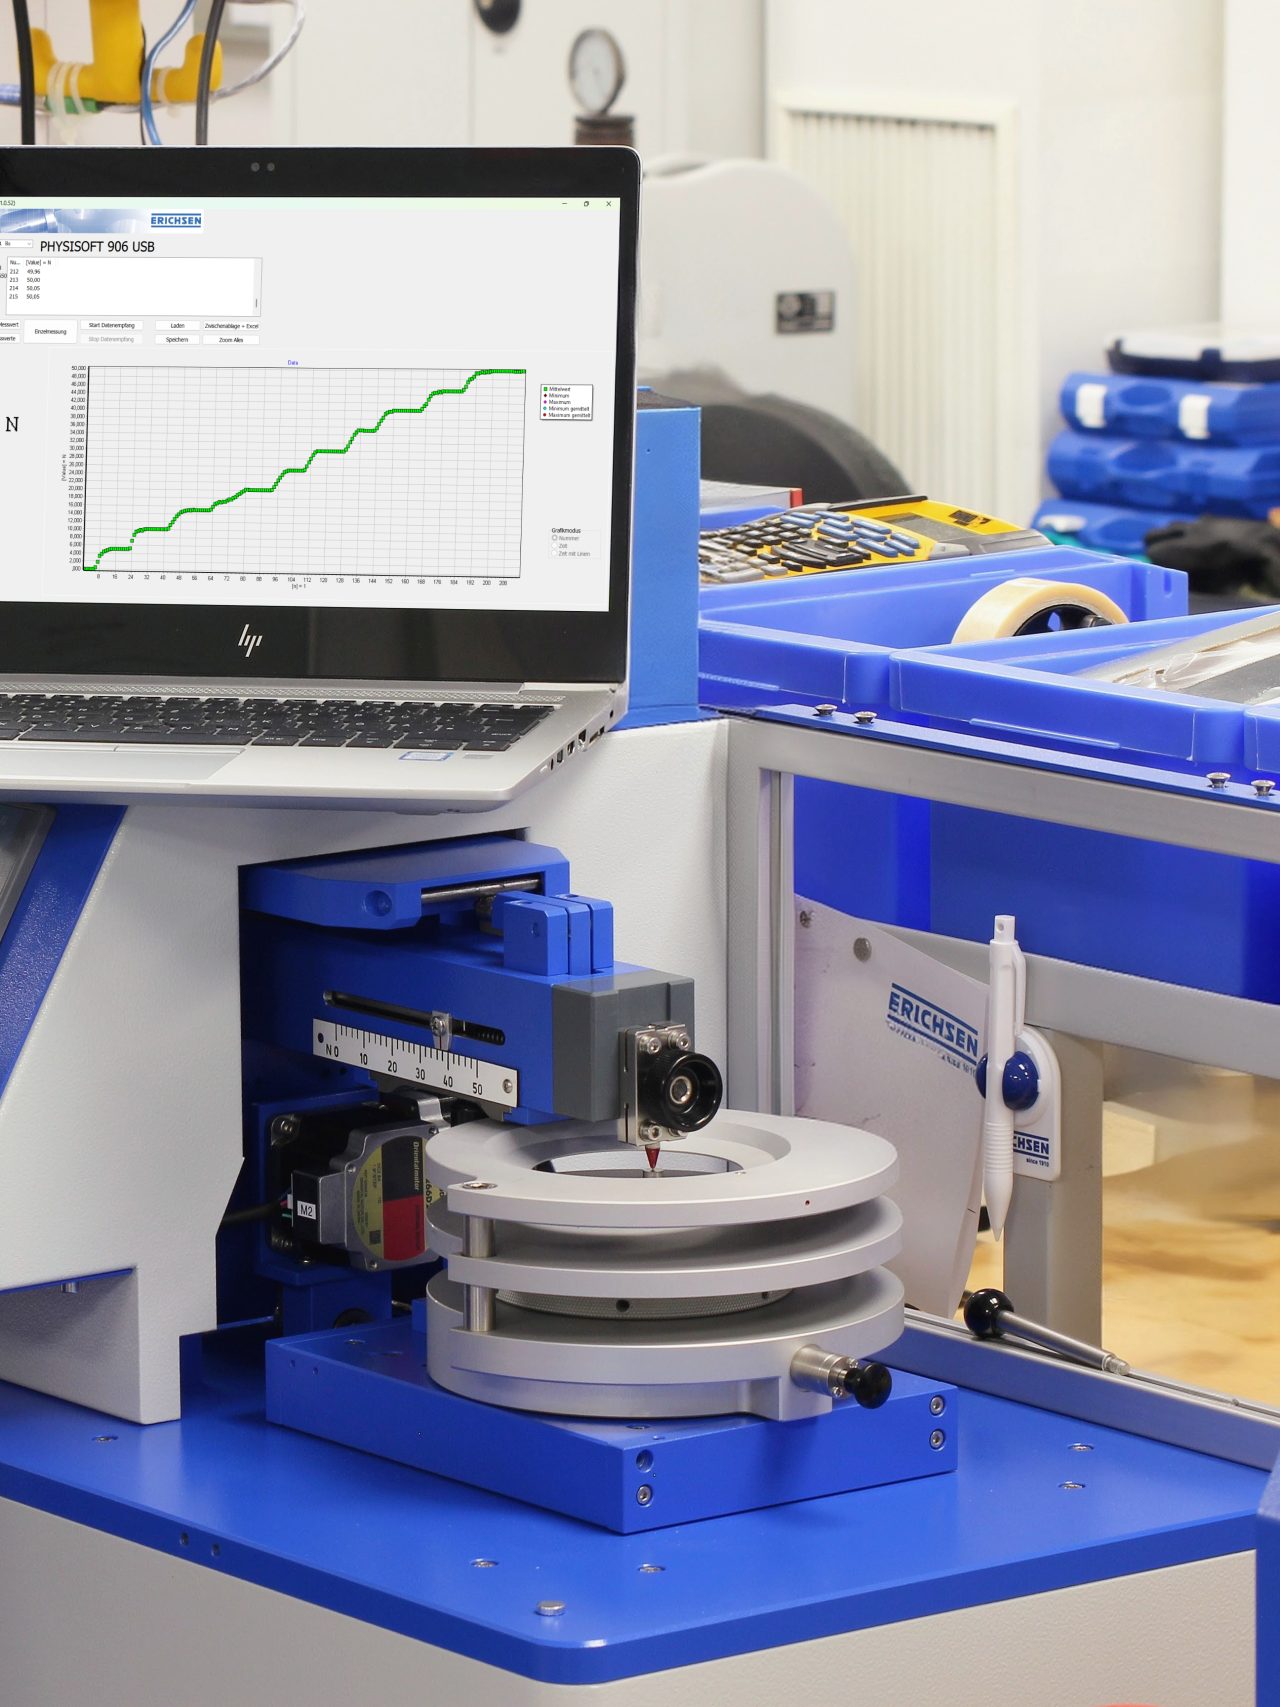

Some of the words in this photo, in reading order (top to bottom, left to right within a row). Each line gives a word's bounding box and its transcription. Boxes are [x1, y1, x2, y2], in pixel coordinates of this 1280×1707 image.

[151, 217, 202, 225] ERICHSEN
[40, 241, 104, 252] PHYSISOFT
[108, 241, 128, 252] 906
[132, 241, 155, 252] USB
[6, 416, 19, 432] N
[238, 624, 263, 658] hp
[888, 991, 978, 1057] ERICHSEN
[326, 1044, 332, 1055] N
[334, 1047, 339, 1057] 0
[359, 1053, 368, 1066] 10
[388, 1060, 397, 1074] 20
[416, 1068, 425, 1081] 30
[443, 1075, 453, 1088] 40
[473, 1083, 483, 1096] 50
[1026, 1157, 1038, 1166] since
[1038, 1158, 1050, 1167] 1910
[300, 1205, 313, 1217] M2
